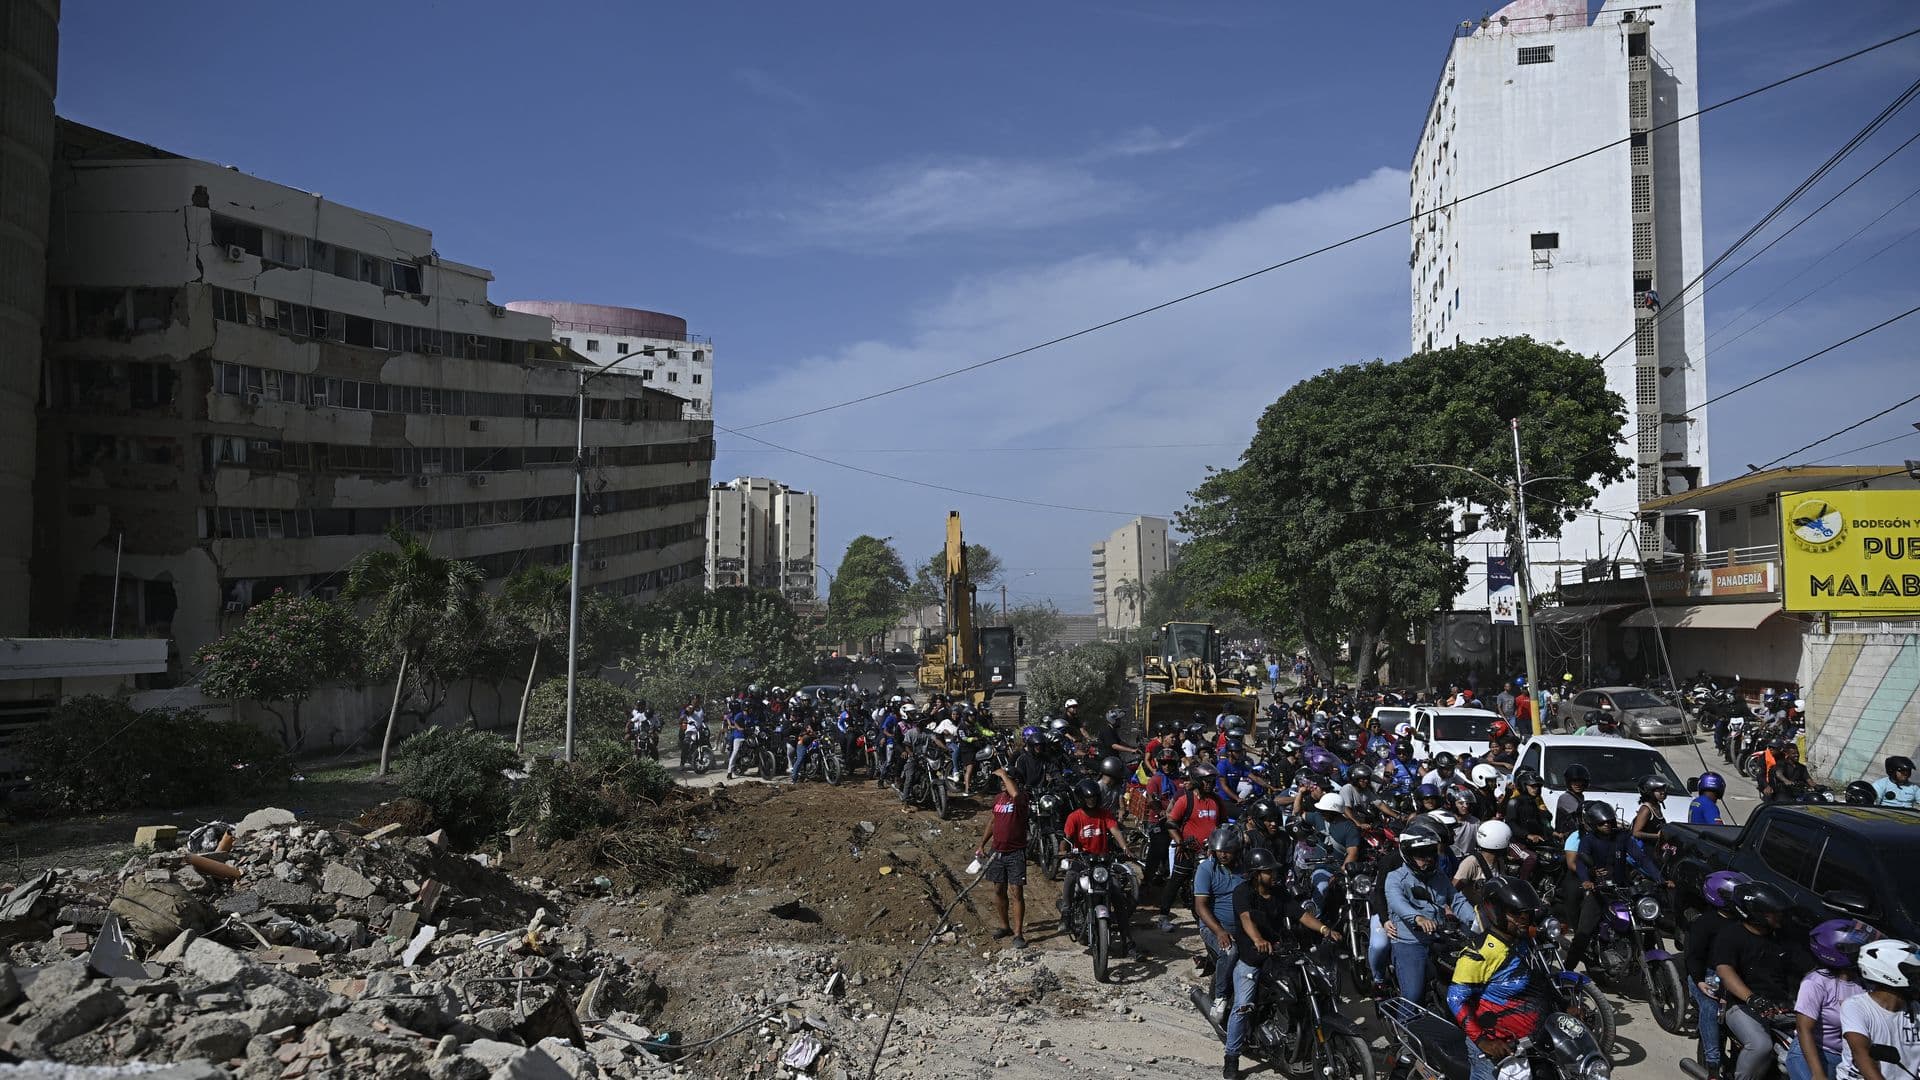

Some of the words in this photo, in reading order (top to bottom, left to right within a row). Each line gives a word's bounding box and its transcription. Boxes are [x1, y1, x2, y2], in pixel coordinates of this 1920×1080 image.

[1853, 516, 1910, 528] BODEGÓN
[1863, 537, 1920, 560] PUE
[1810, 574, 1920, 597] MALAB
